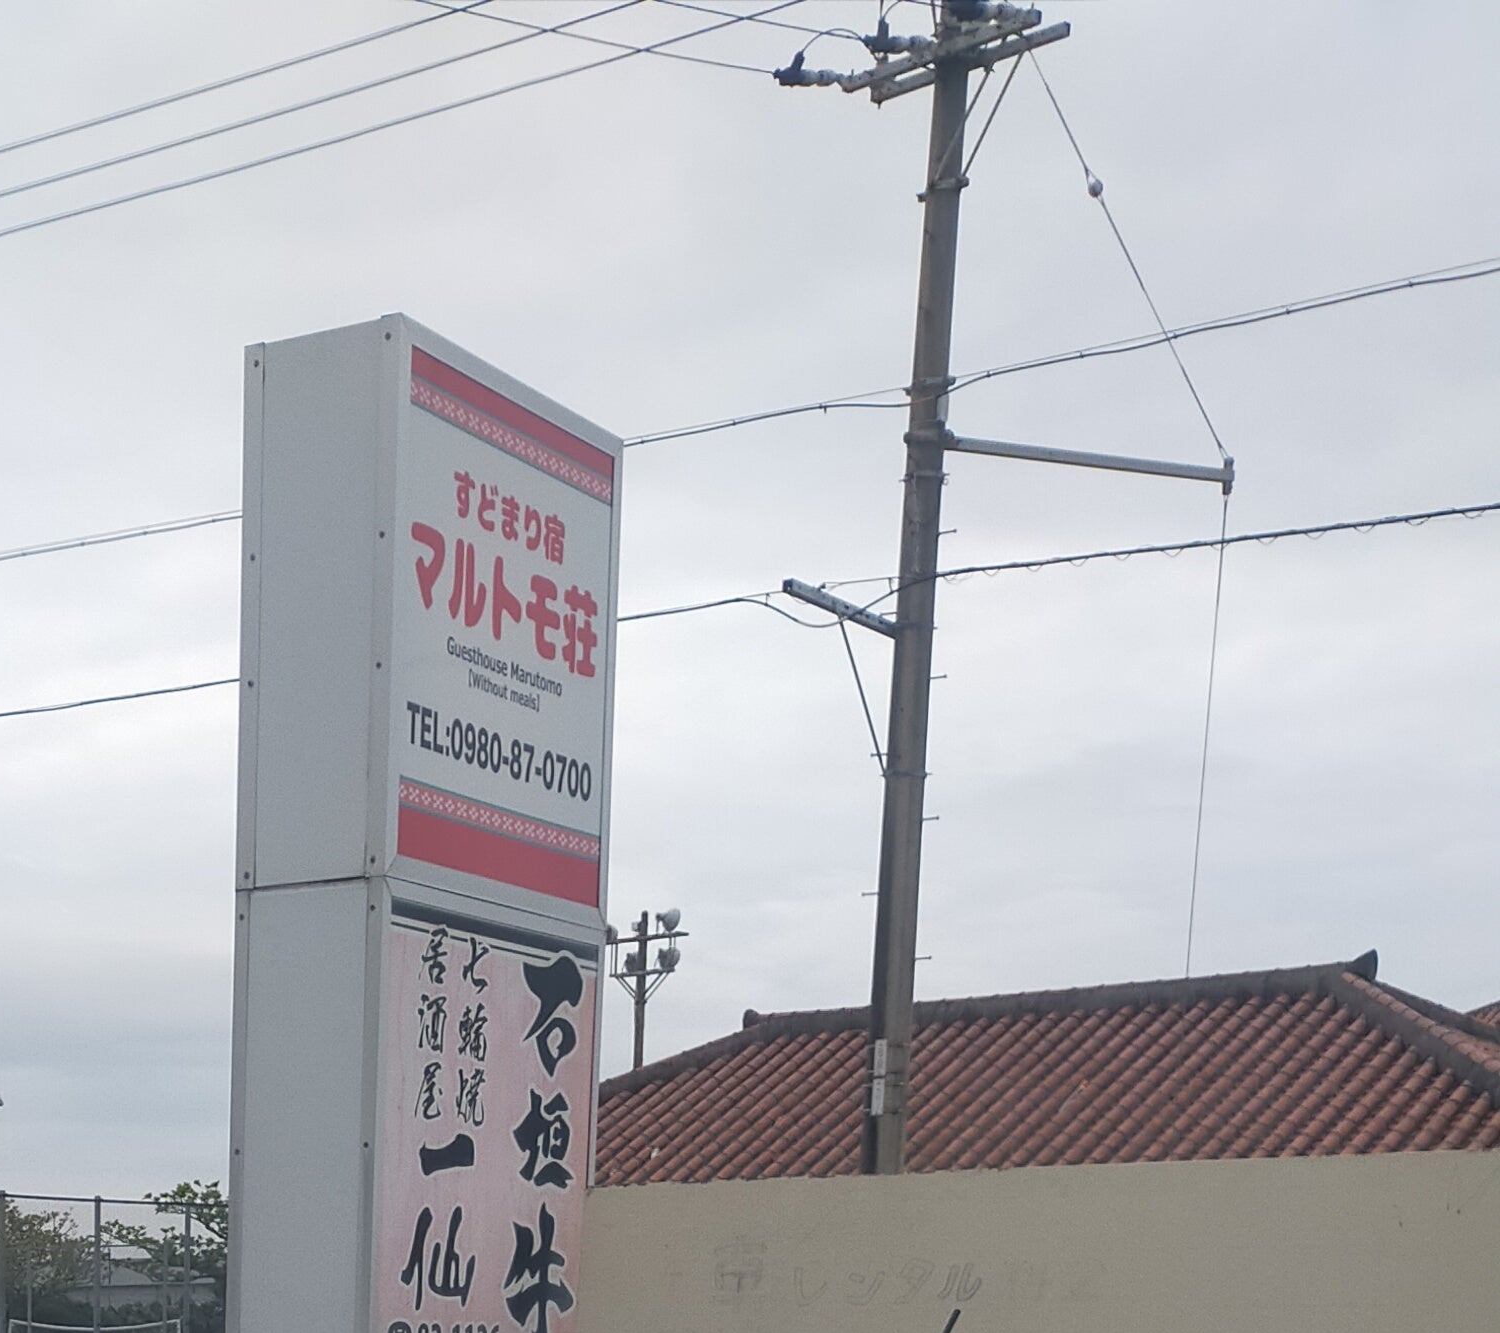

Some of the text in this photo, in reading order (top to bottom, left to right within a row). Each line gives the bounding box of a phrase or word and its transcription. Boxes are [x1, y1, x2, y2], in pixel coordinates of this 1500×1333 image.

[453, 470, 566, 565] すどまり宿
[410, 522, 598, 677] マルトモ荘
[446, 636, 563, 697] Guesthouse Marutomo
[406, 701, 592, 802] TEL:0980-87-0700
